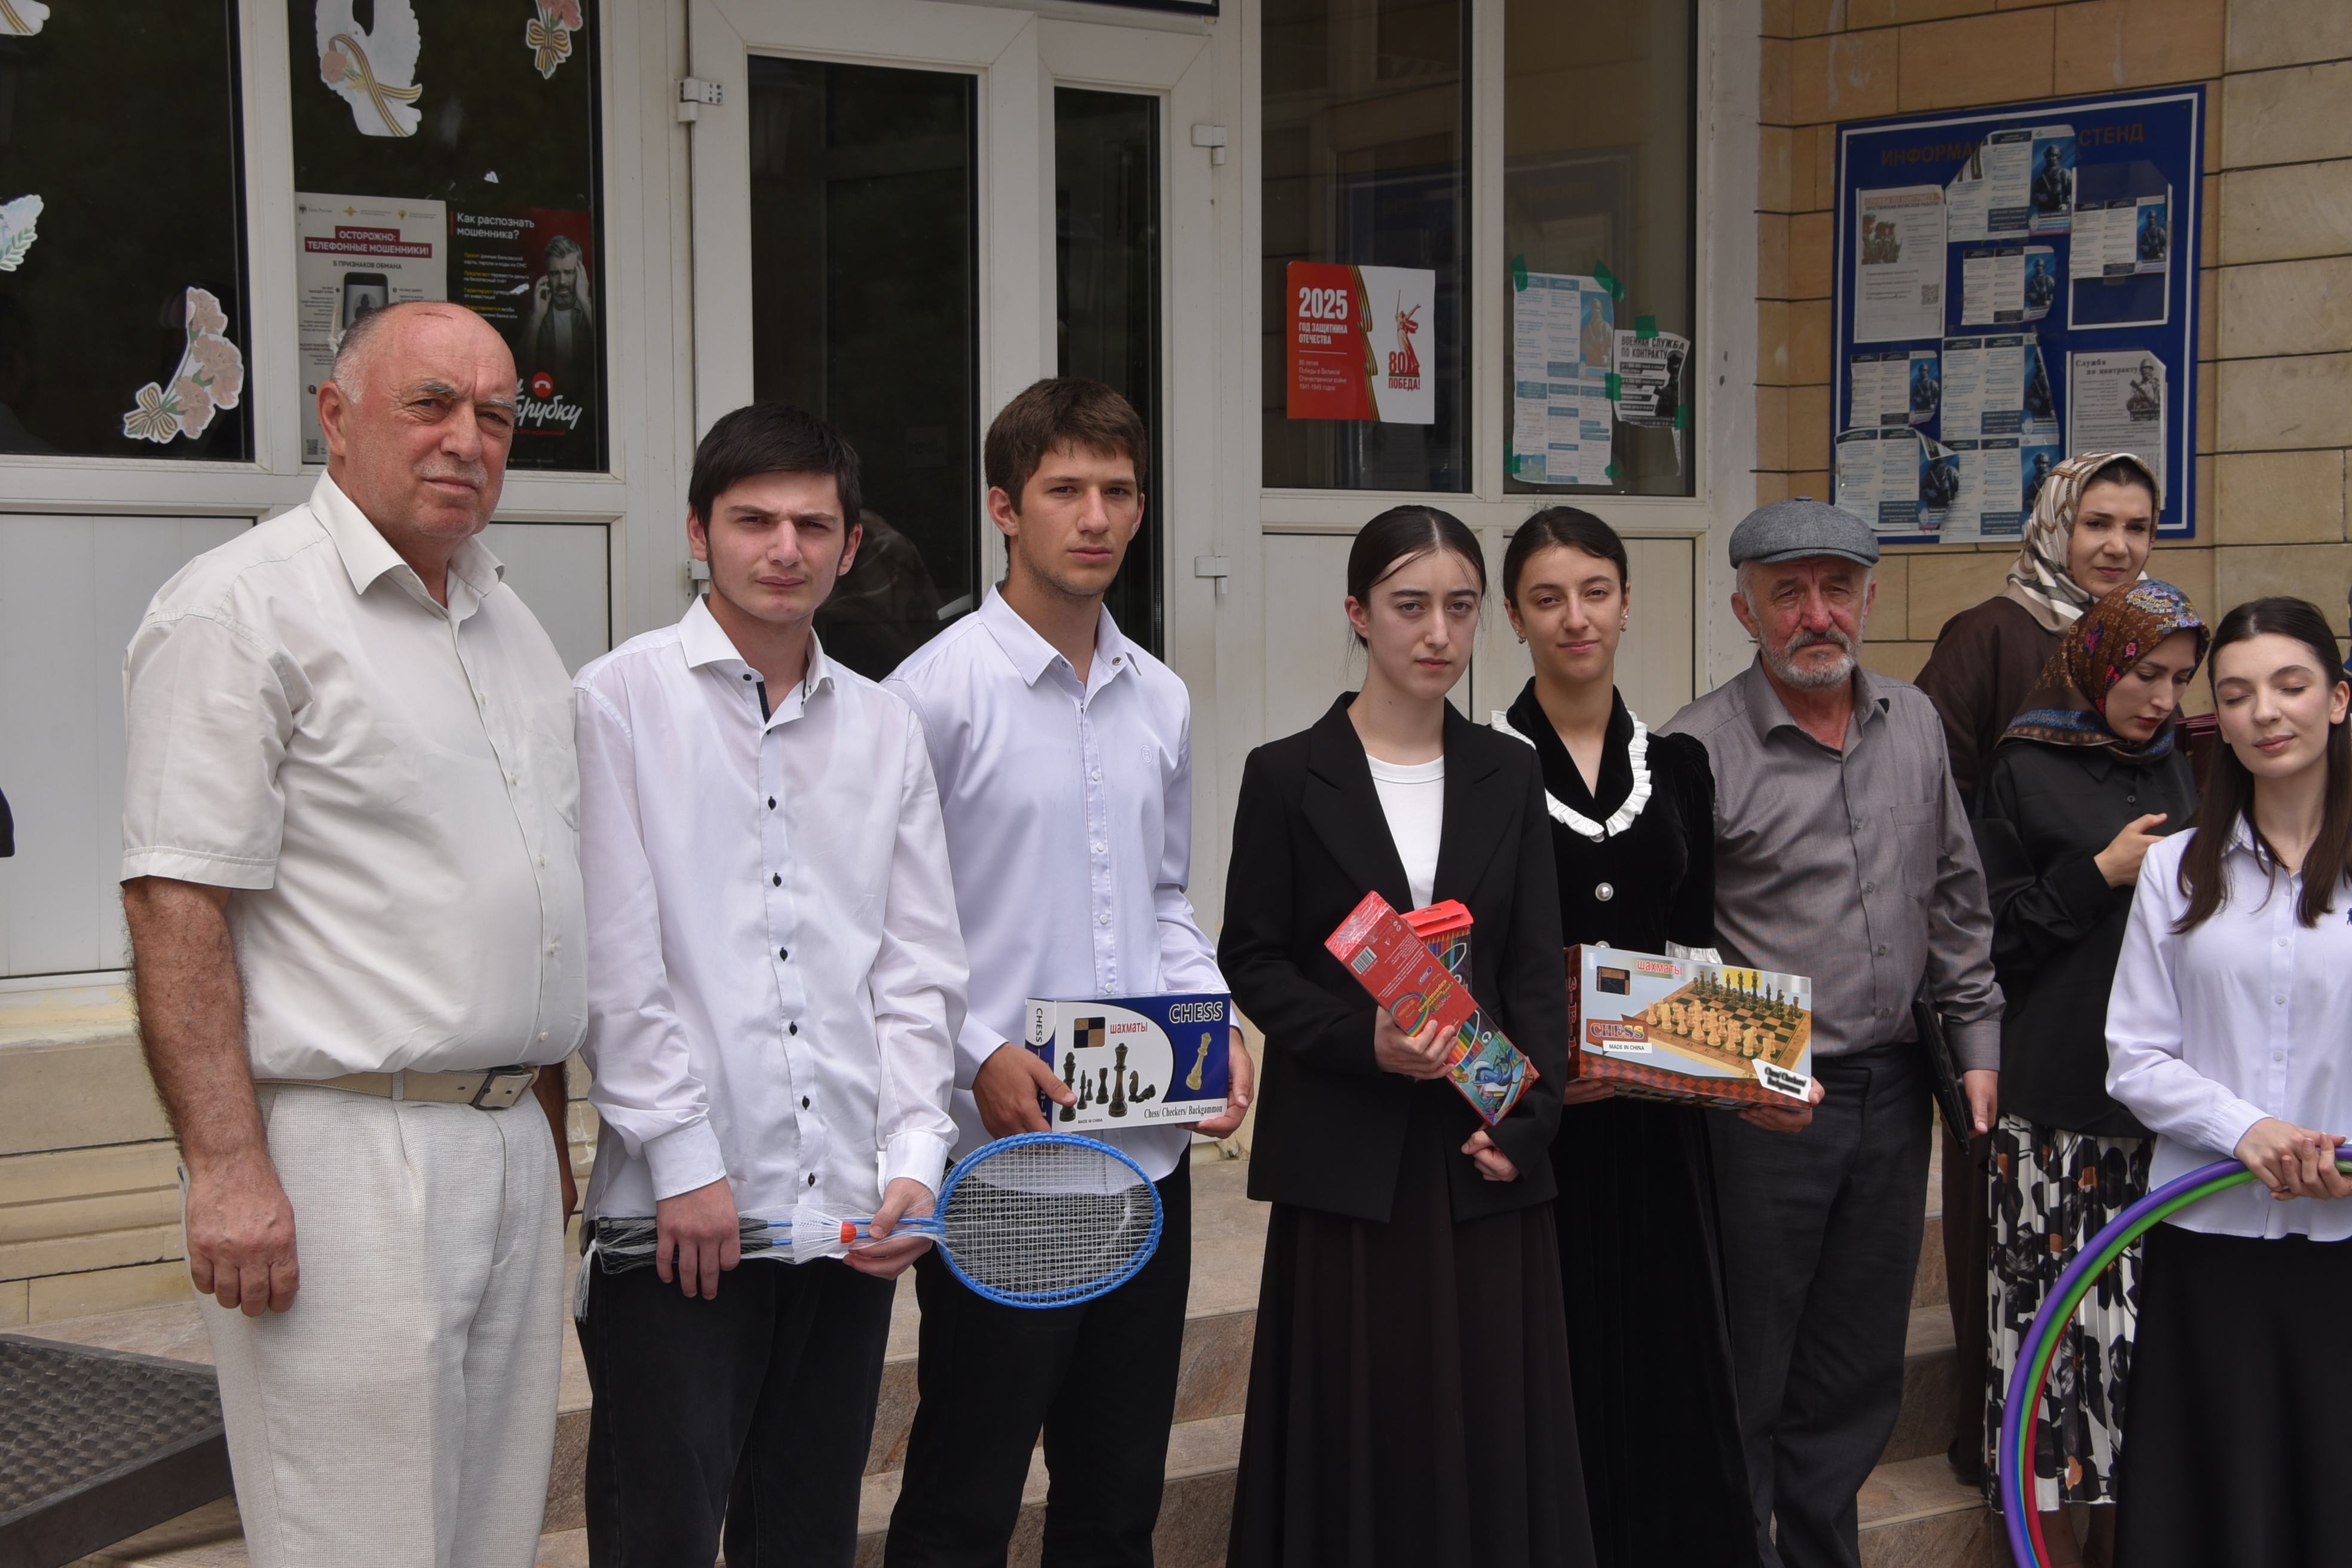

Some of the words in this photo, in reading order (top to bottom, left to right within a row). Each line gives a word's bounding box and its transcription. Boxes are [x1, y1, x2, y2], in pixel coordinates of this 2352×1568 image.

[1881, 140, 1982, 167] ИНФОРМА
[2078, 123, 2145, 147] СТЕНД
[457, 213, 475, 223] Как
[478, 216, 535, 228] распознать
[339, 230, 396, 241] ОСТОРОЖНО:
[457, 228, 519, 240] мошенника?
[307, 241, 368, 252] ТЕЛЕФОННЫЕ
[369, 244, 429, 255] МОШЕННИКИ!
[1299, 287, 1348, 320] 2025
[1299, 322, 1311, 332] ГОД
[1312, 322, 1348, 334] ЗАЩИТНИКА
[1299, 334, 1331, 344] ОТЕЧЕСТВА
[1621, 335, 1649, 347] ВОЕННАЯ
[1652, 338, 1685, 351] СЛУЖБА
[1621, 348, 1630, 357] ПО
[1632, 350, 1668, 360] КОНТРАКТУ
[1389, 351, 1407, 373] 80
[2075, 359, 2106, 368] Служба
[1389, 377, 1420, 391] ПОБЕДА!
[1637, 960, 1683, 975] шахматы
[1417, 979, 1448, 1013] карандашей
[1169, 1001, 1223, 1024] CHESS
[1110, 1021, 1148, 1034] шахматы
[1590, 1022, 1644, 1039] CHESS
[1144, 1108, 1161, 1119] Chess/
[1162, 1106, 1188, 1117] Checkers/
[1189, 1105, 1223, 1116] Backgammon
